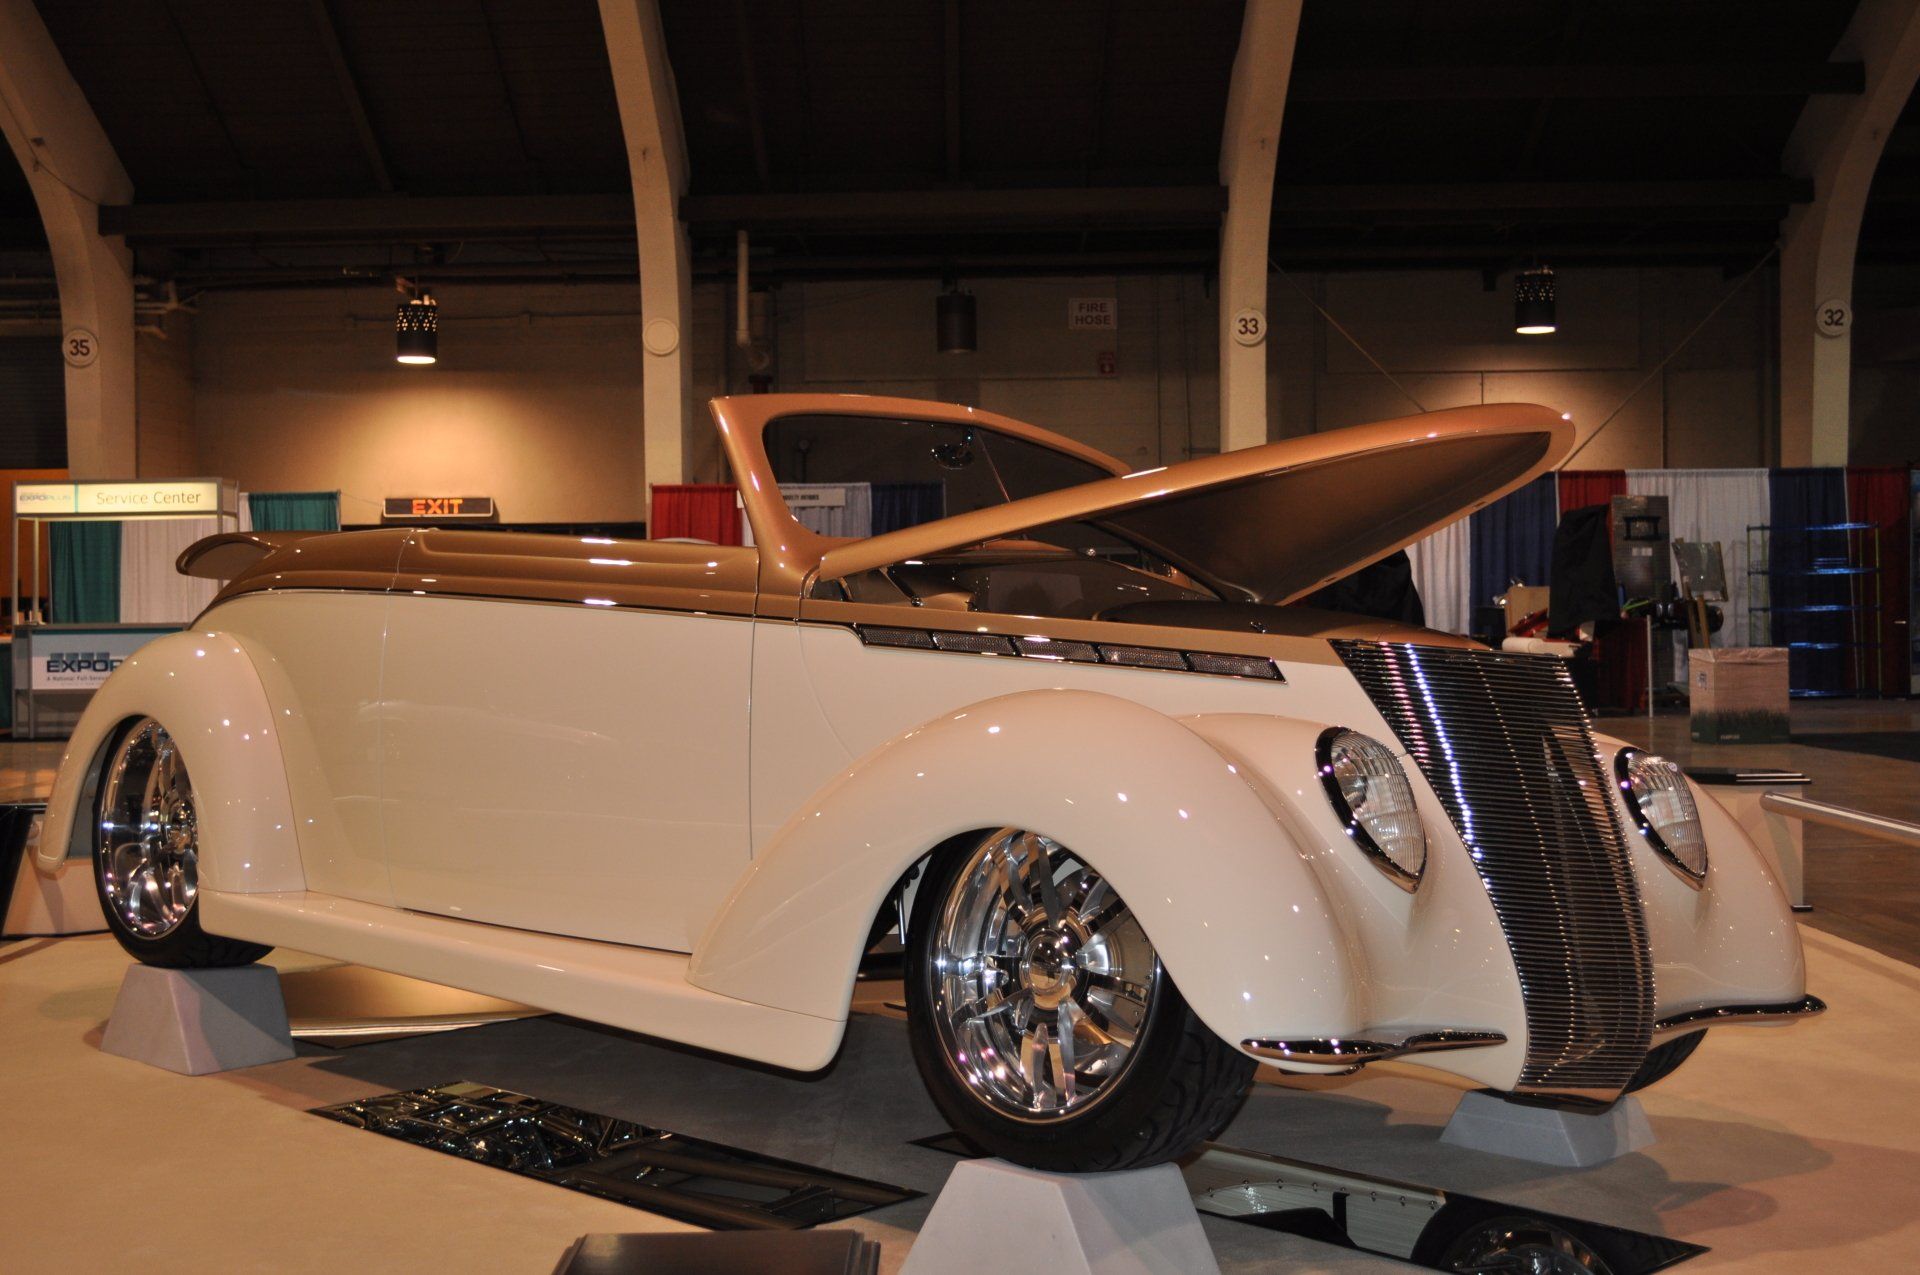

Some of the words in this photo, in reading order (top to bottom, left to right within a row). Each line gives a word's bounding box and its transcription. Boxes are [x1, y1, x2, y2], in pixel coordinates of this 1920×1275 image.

[1078, 302, 1108, 313] FIRE
[1075, 315, 1111, 325] HOSE
[1824, 309, 1844, 326] 32
[1238, 318, 1259, 335] 33
[70, 339, 90, 356] 35
[97, 492, 149, 505] Service
[153, 491, 202, 504] Center
[412, 499, 464, 515] EXIT
